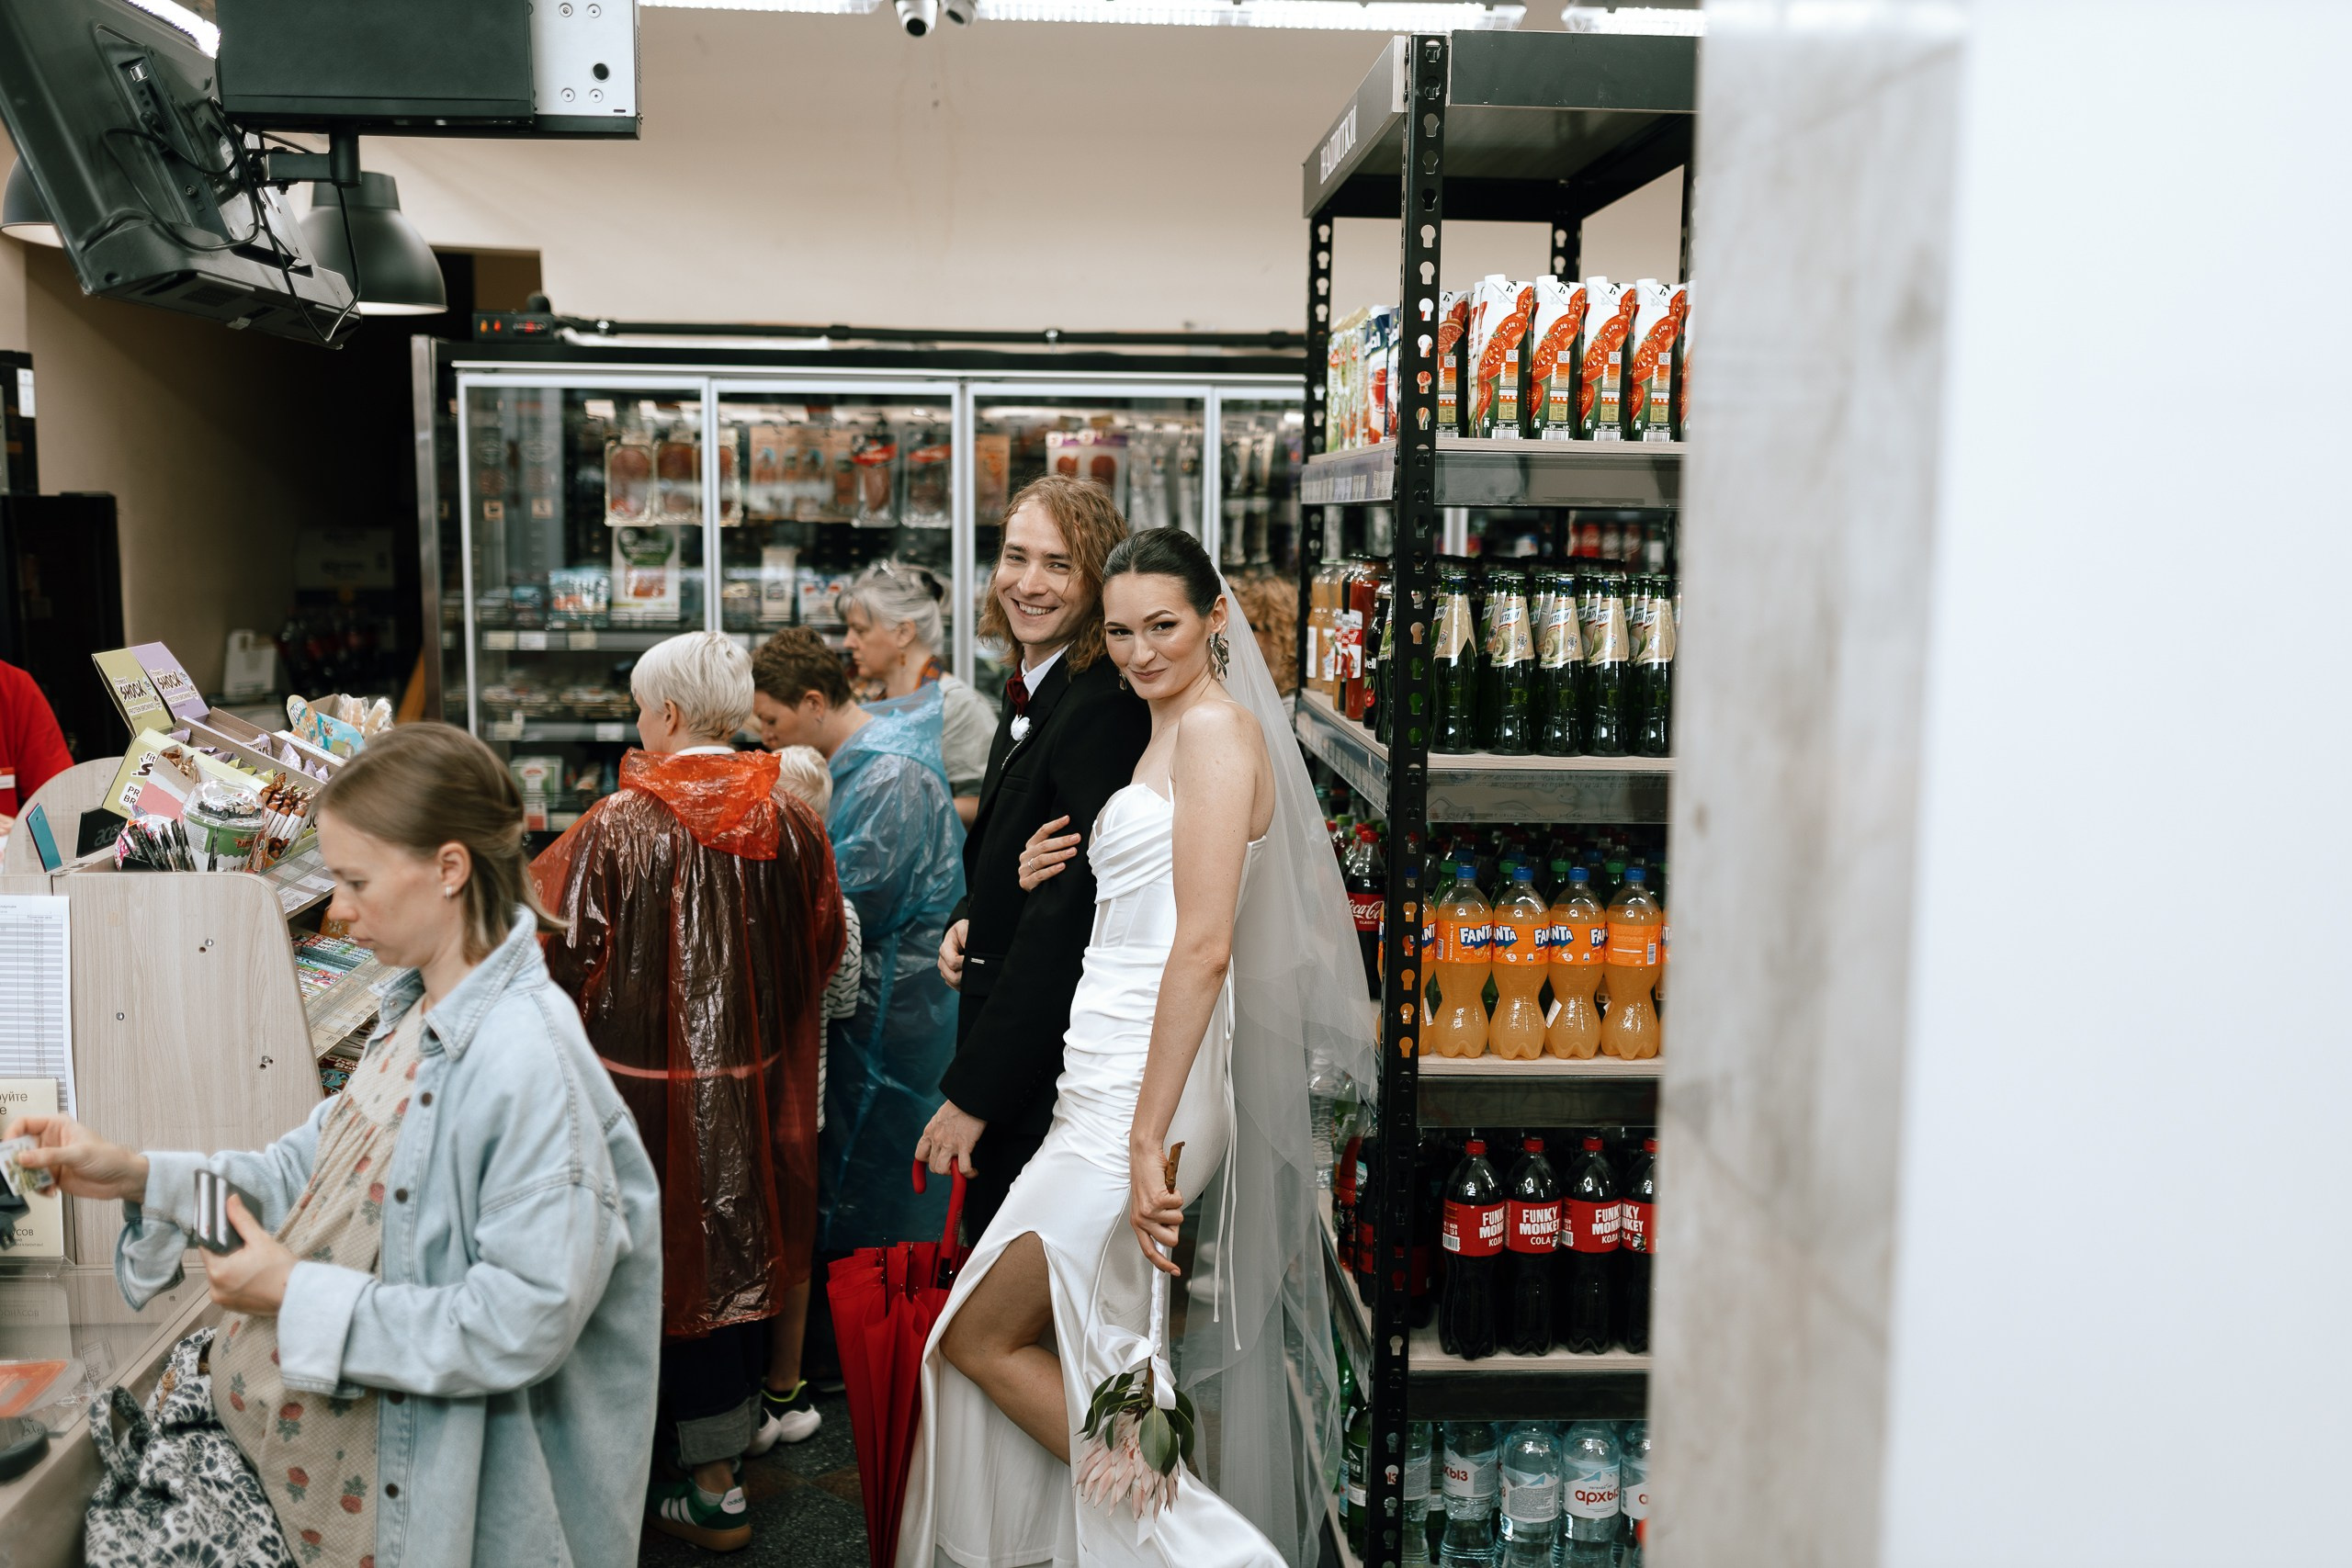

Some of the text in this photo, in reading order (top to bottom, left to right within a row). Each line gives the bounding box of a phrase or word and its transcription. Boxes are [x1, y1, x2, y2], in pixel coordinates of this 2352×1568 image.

[156, 671, 184, 692] SHOCK
[119, 680, 147, 702] SHOCK
[1550, 925, 1573, 941] NTA
[1522, 1206, 1558, 1224] FUNKY
[1519, 1218, 1560, 1235] MONKEY
[1530, 1235, 1551, 1245] COLA
